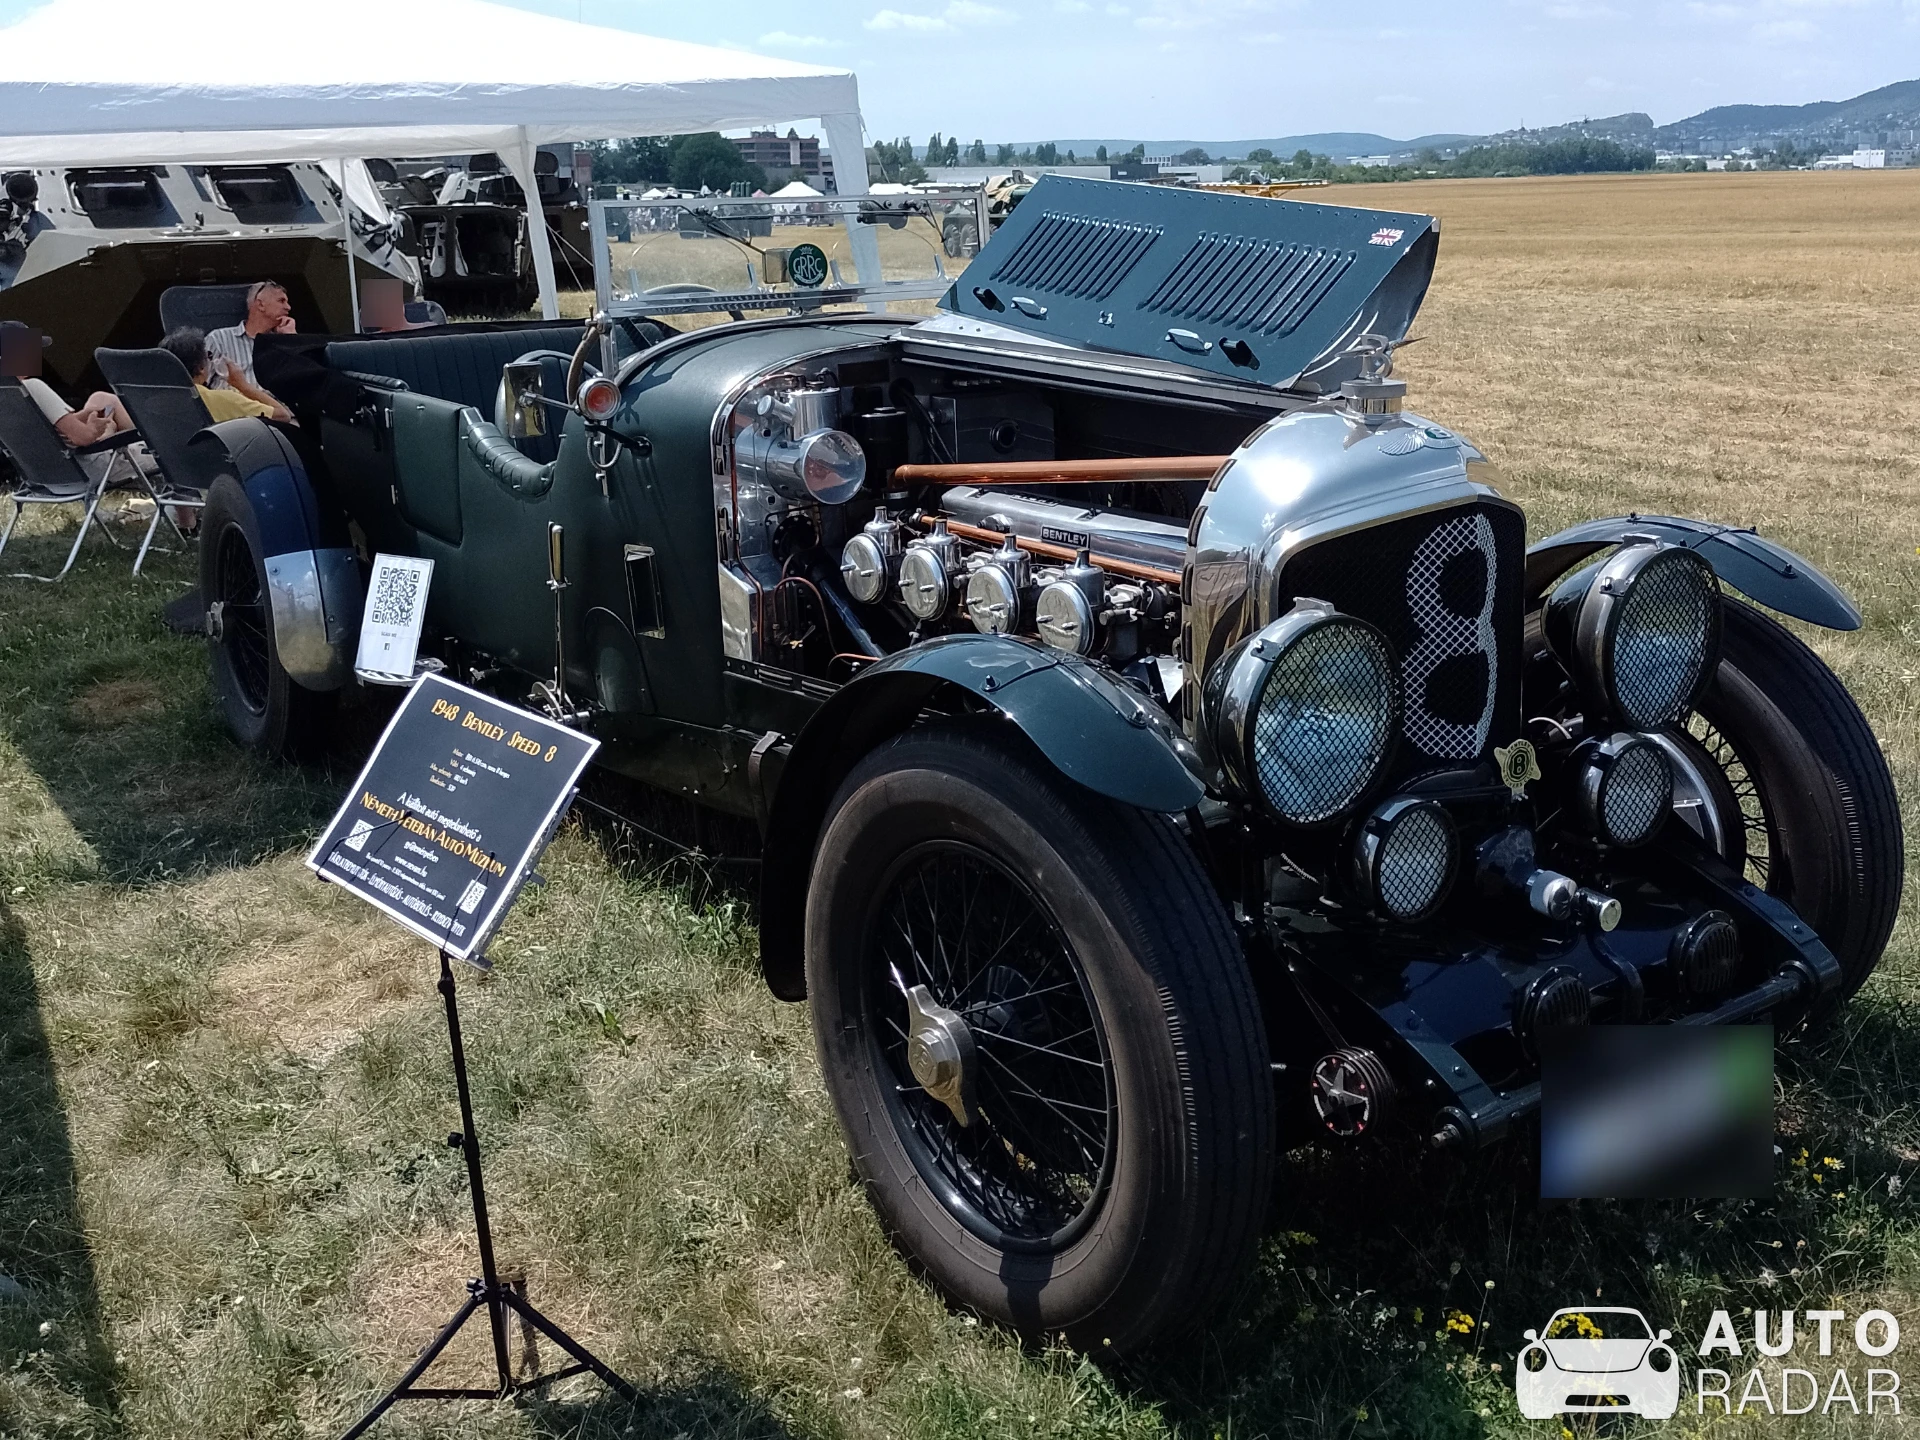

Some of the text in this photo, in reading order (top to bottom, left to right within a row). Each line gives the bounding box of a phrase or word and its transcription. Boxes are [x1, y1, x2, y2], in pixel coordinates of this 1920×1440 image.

[793, 255, 823, 280] GRRC
[1042, 528, 1087, 546] BENTLEY
[1401, 513, 1497, 759] 8
[431, 699, 460, 721] 1948
[508, 732, 540, 755] SPEED
[545, 746, 557, 762] 8
[360, 792, 399, 822] NÉMETH
[435, 830, 465, 855] AUTÓ
[397, 792, 406, 804] A
[425, 808, 438, 820] autó
